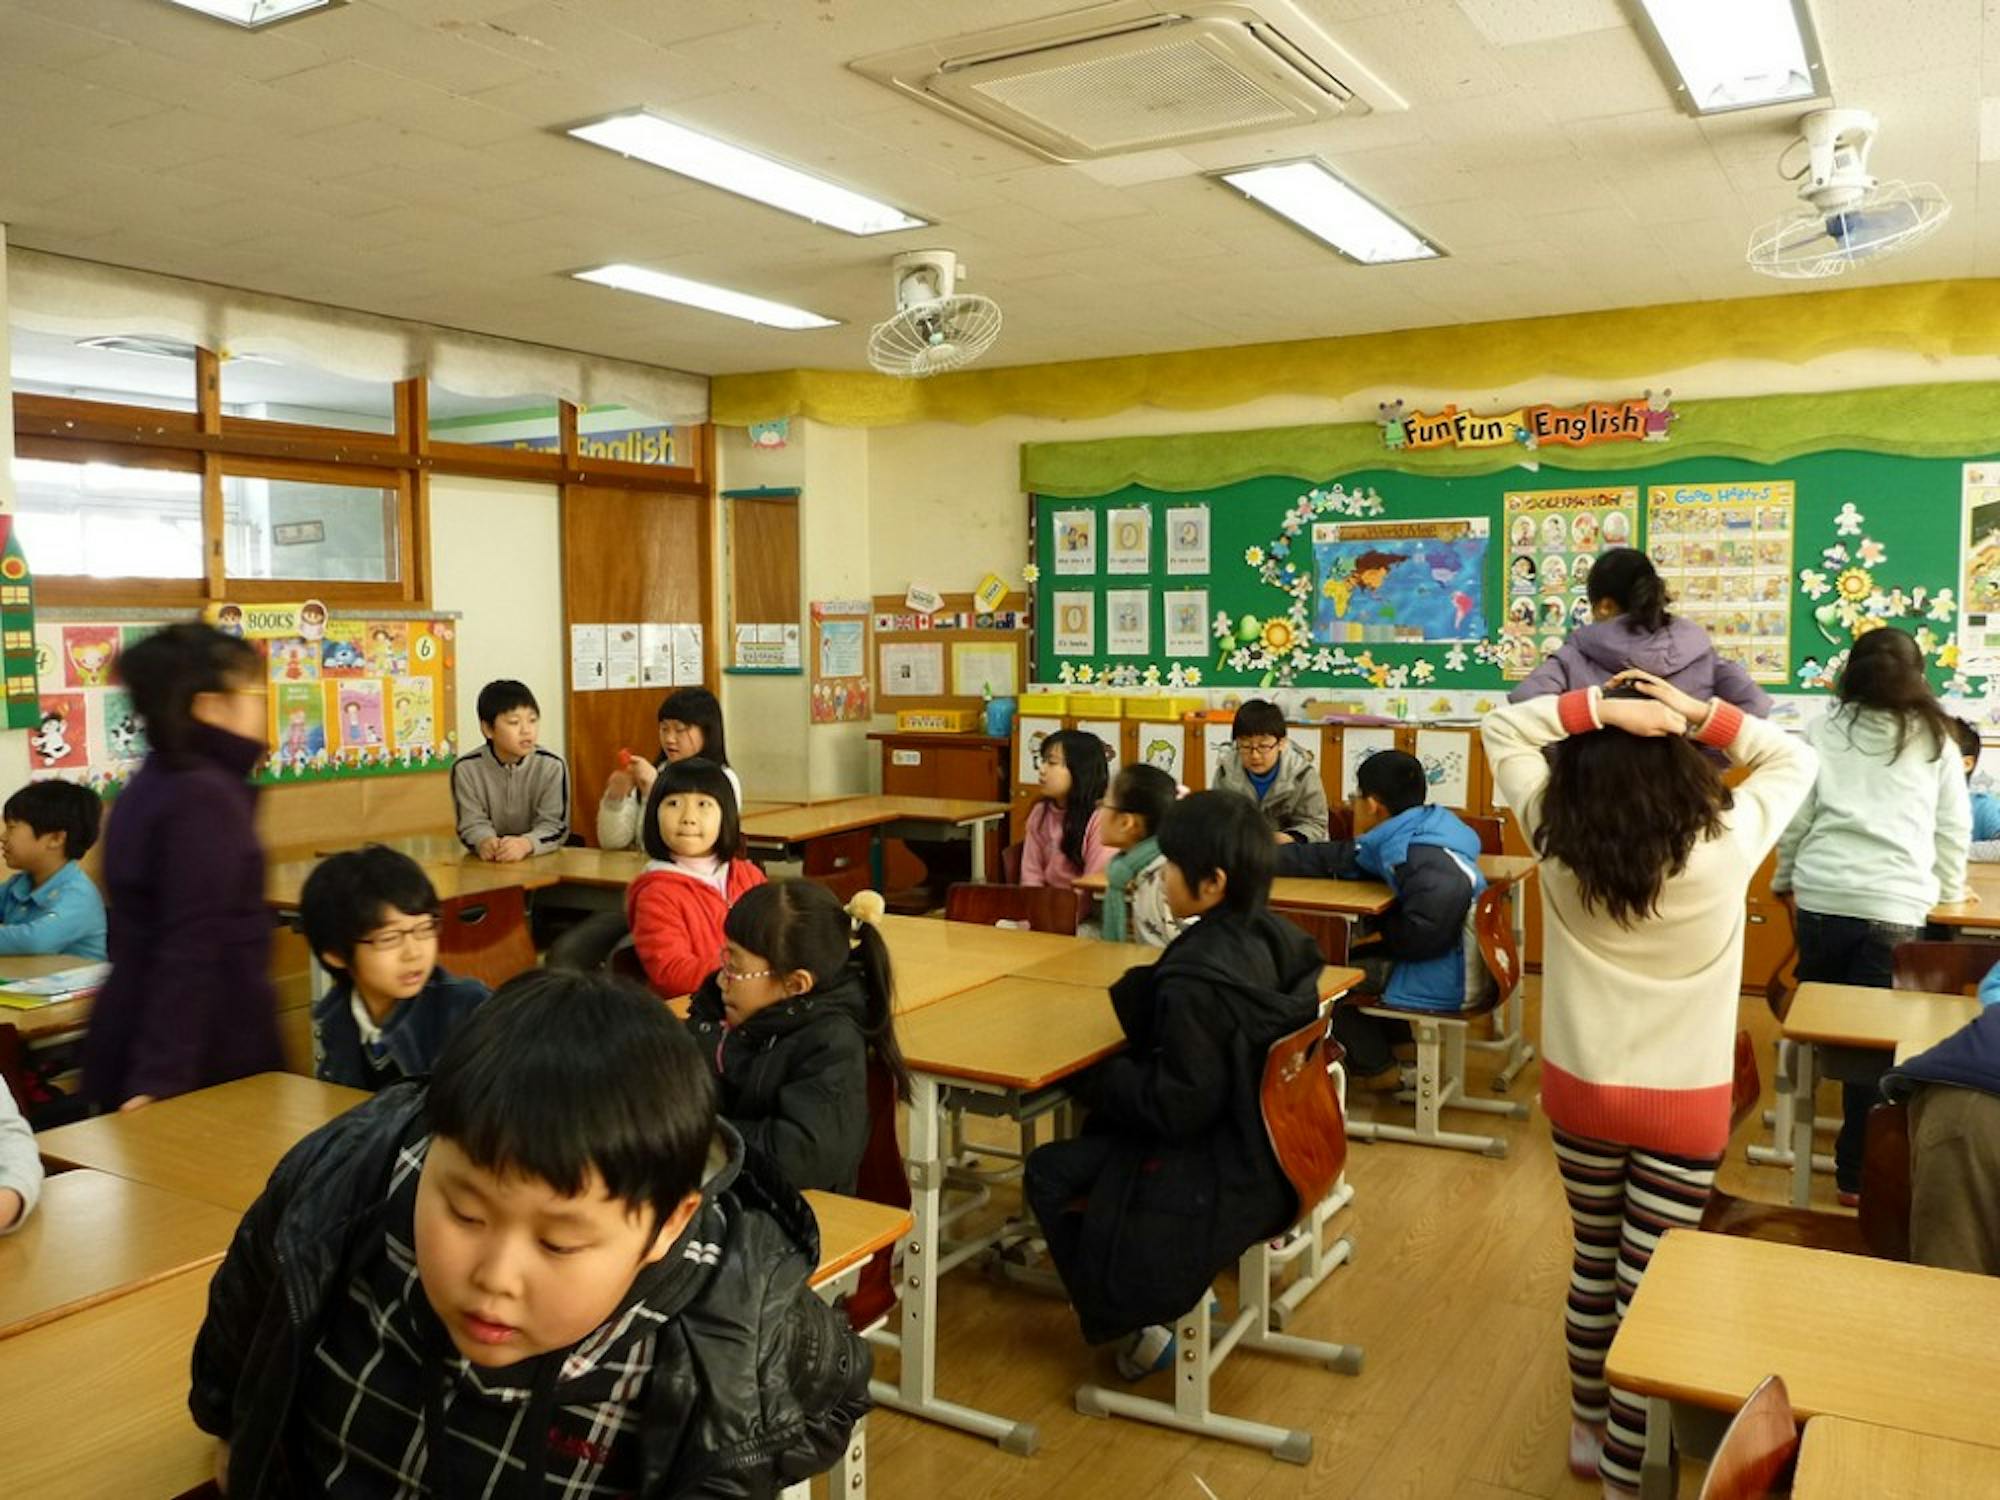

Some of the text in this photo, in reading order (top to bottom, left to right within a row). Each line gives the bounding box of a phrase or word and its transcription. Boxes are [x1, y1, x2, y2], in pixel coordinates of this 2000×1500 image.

[1404, 419, 1450, 444] Fun
[1535, 406, 1639, 440] English
[248, 612, 294, 629] BOOKS
[420, 638, 431, 657] 6
